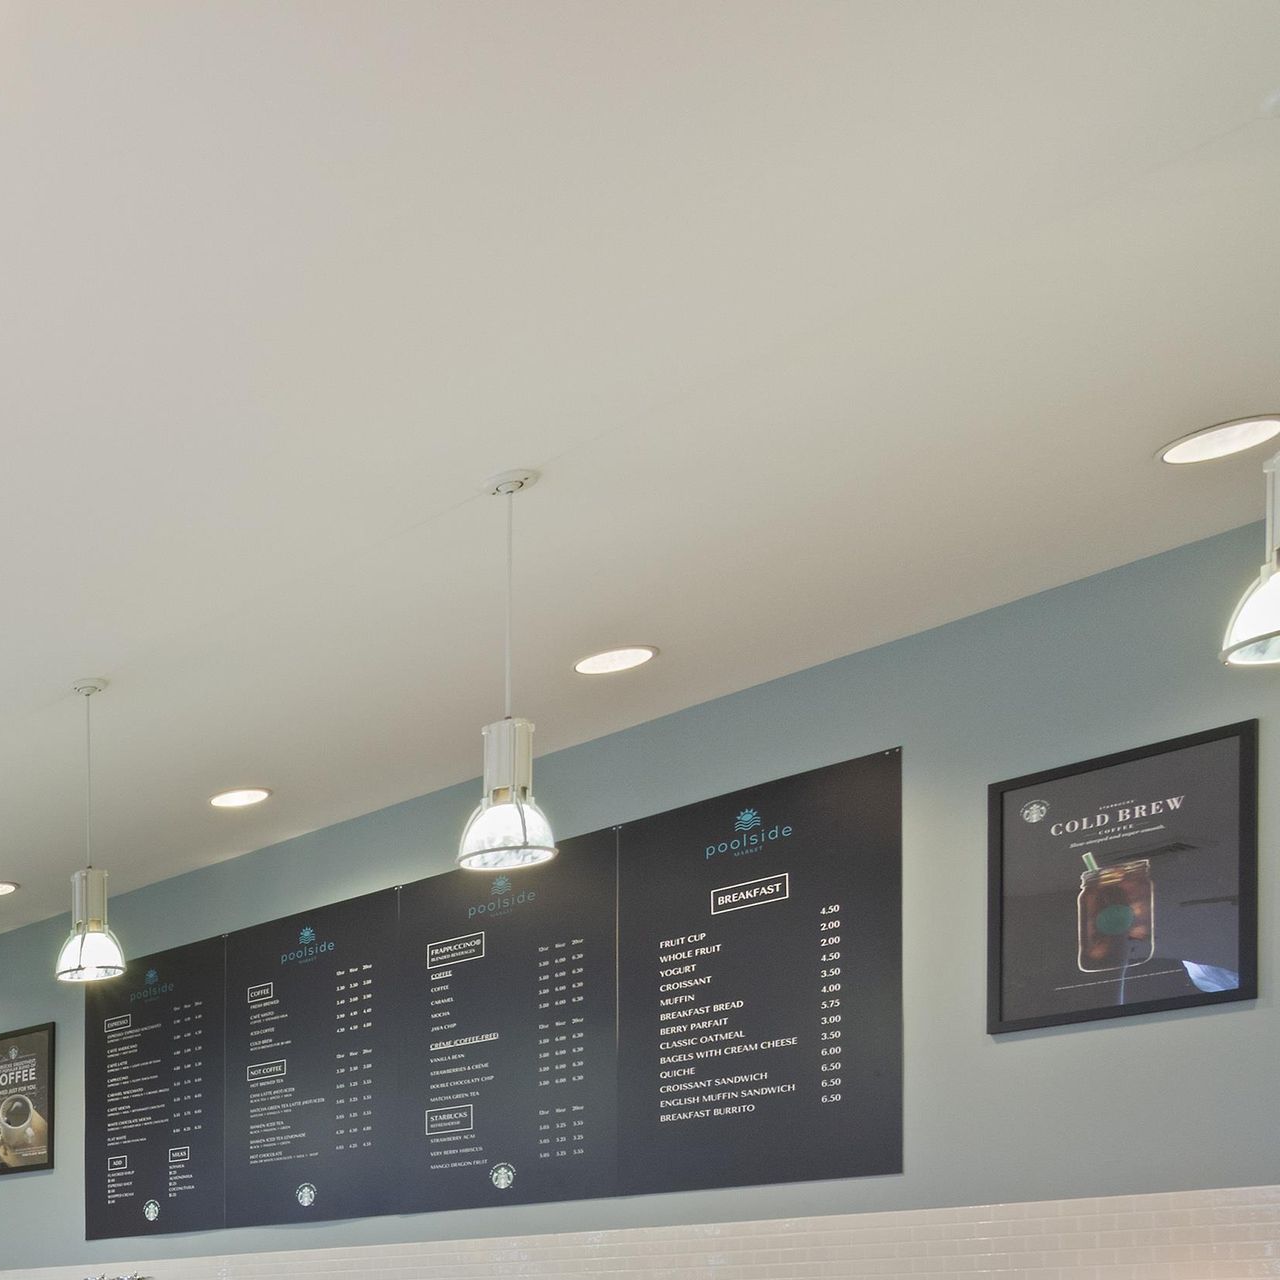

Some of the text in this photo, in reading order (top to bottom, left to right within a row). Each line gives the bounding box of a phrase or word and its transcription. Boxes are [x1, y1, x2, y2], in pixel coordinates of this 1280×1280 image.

[1051, 796, 1184, 836] COLD BREW
[1098, 824, 1133, 835] COFFEE
[705, 825, 793, 859] poolside
[734, 846, 763, 857] MARKET
[718, 883, 781, 906] BREAKFAST
[468, 891, 536, 918] poolside
[820, 904, 840, 915] 4.50
[820, 920, 840, 931] 2.00
[660, 933, 706, 949] FRUIT CUP
[821, 936, 840, 946] 2.00
[281, 942, 334, 964] poolside
[431, 949, 475, 962] BLENDED BEVERAGES
[660, 944, 721, 963] WHOLE FRUIT
[821, 952, 840, 962] 4.50
[431, 970, 452, 979] COFFEE
[660, 964, 696, 978] YOGURT
[821, 968, 840, 978] 3.50
[431, 985, 449, 993] COFFEE
[660, 976, 712, 992] CROISSANT
[821, 984, 840, 993] 4.00
[130, 983, 174, 1000] poolside
[250, 988, 270, 998] COFFEE
[431, 997, 453, 1006] CARAMEL
[660, 994, 695, 1007] MUFFIN
[821, 999, 840, 1009] 5.75
[660, 1000, 744, 1021] BREAKFAST BREAD
[108, 1020, 128, 1028] ESPRESSO
[821, 1015, 841, 1025] 3.00
[660, 1018, 728, 1036] BERRY PARFAIT
[660, 1030, 745, 1050] CLASSIC OATMEAL
[821, 1031, 840, 1041] 3.50
[660, 1037, 798, 1065] BAGELS WITH CREAM CHEESE
[821, 1046, 841, 1056] 6.00
[251, 1065, 282, 1076] NOT COFFEE
[430, 1066, 466, 1076] STRAWBERRIES
[822, 1062, 841, 1072] 6.50
[660, 1067, 695, 1079] QUICHE
[450, 1077, 480, 1087] CHOCOLATY
[660, 1072, 768, 1094] CROISSANT SANDWICH
[822, 1078, 841, 1088] 6.50
[660, 1084, 795, 1108] ENGLISH MUFFIN SANDWICH
[822, 1094, 841, 1104] 6.50
[430, 1112, 467, 1121] STARBUCKS
[660, 1104, 755, 1123] BREAKFAST BURRITO
[430, 1135, 462, 1143] STRAWBERRY
[450, 1160, 472, 1168] DRAGON
